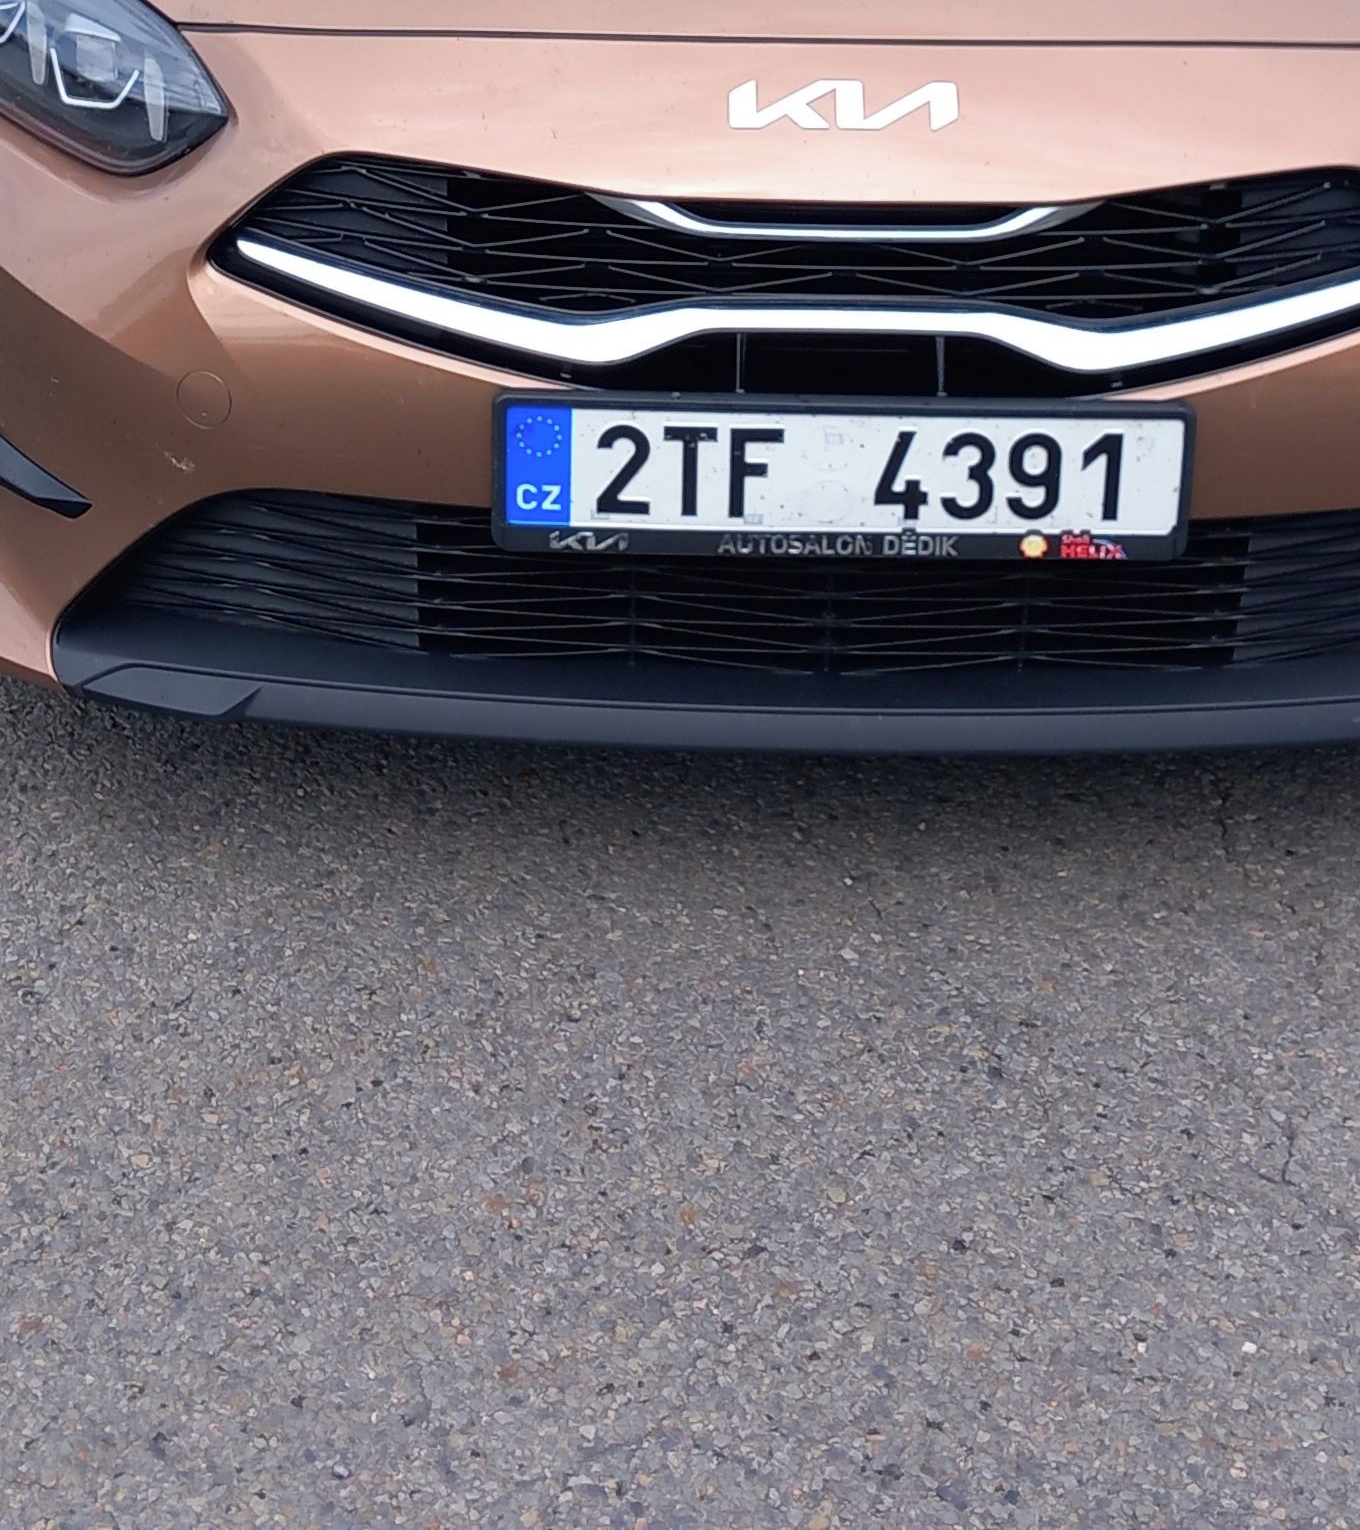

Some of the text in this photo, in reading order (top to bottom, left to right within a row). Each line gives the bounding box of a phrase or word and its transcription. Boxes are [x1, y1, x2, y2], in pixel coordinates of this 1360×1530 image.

[727, 78, 959, 131] KIA
[516, 424, 1124, 521] CZ 2TF 4391
[717, 533, 872, 555] AUTOSALON
[1061, 544, 1125, 559] HELIX
